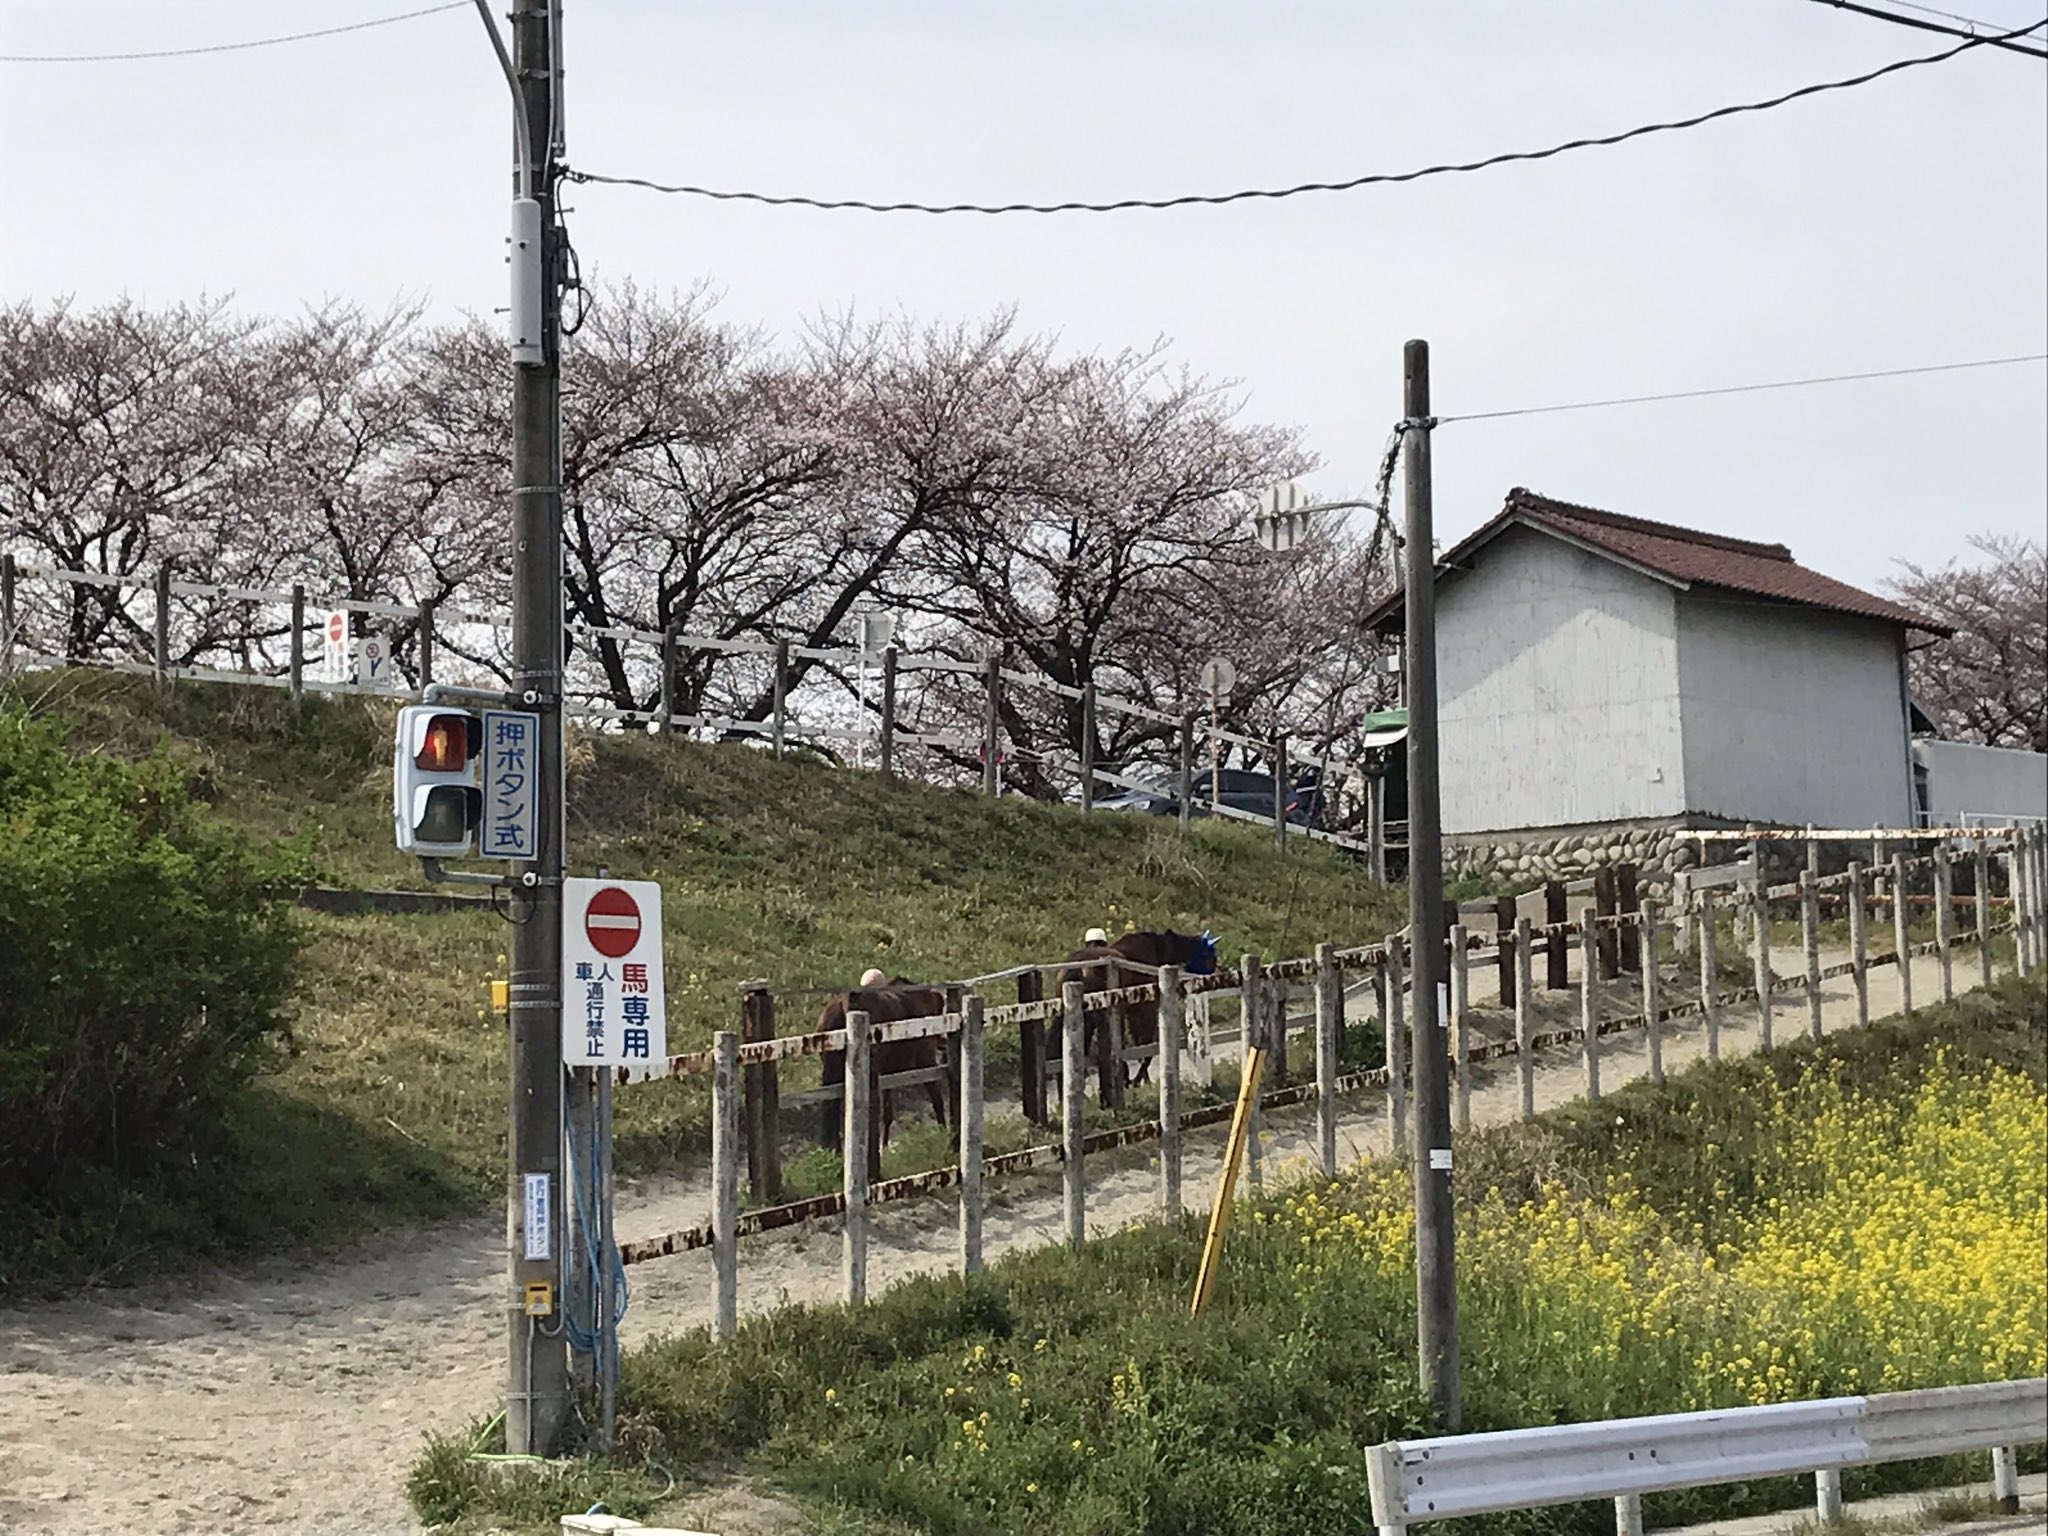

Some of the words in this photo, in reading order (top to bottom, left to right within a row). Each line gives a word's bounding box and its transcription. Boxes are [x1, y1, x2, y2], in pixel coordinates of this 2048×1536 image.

[495, 720, 525, 849] 押ボタン式
[621, 963, 650, 1058] 馬専用
